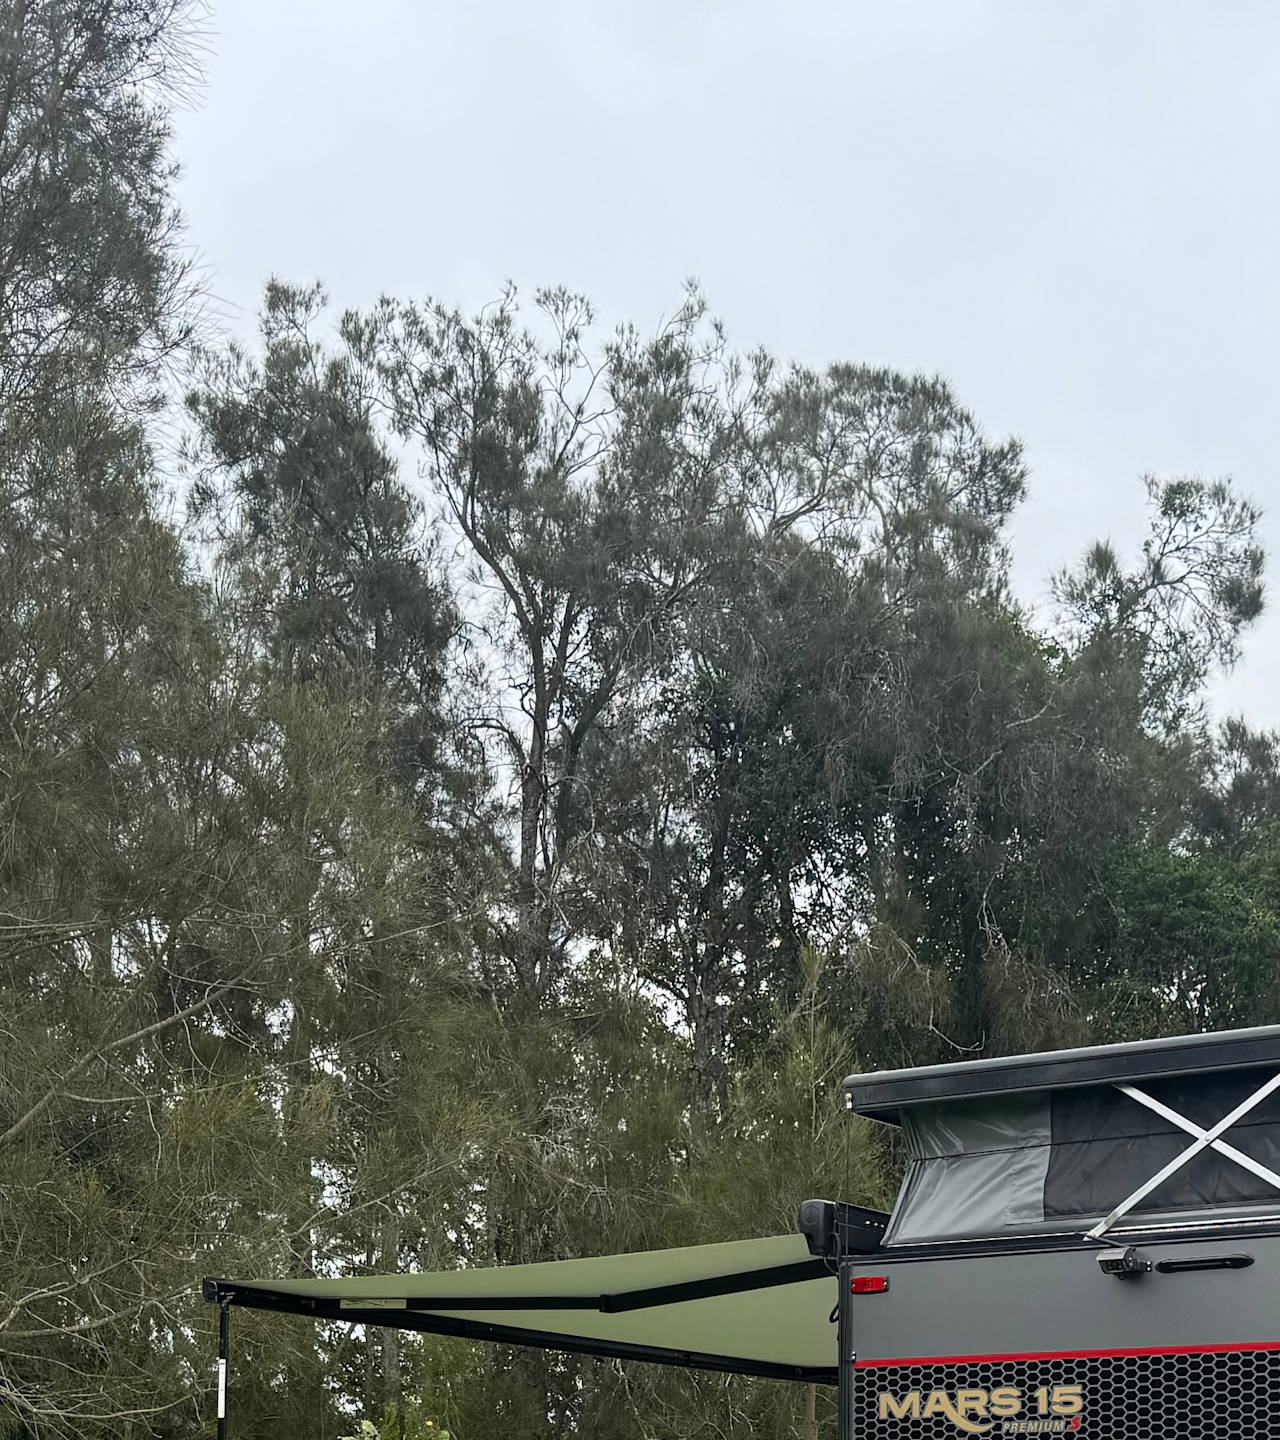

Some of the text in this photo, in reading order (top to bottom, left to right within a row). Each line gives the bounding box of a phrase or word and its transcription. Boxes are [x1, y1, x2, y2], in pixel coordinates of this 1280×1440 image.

[878, 1385, 1084, 1432] MARS 15
[1001, 1420, 1066, 1434] PREMIUM
